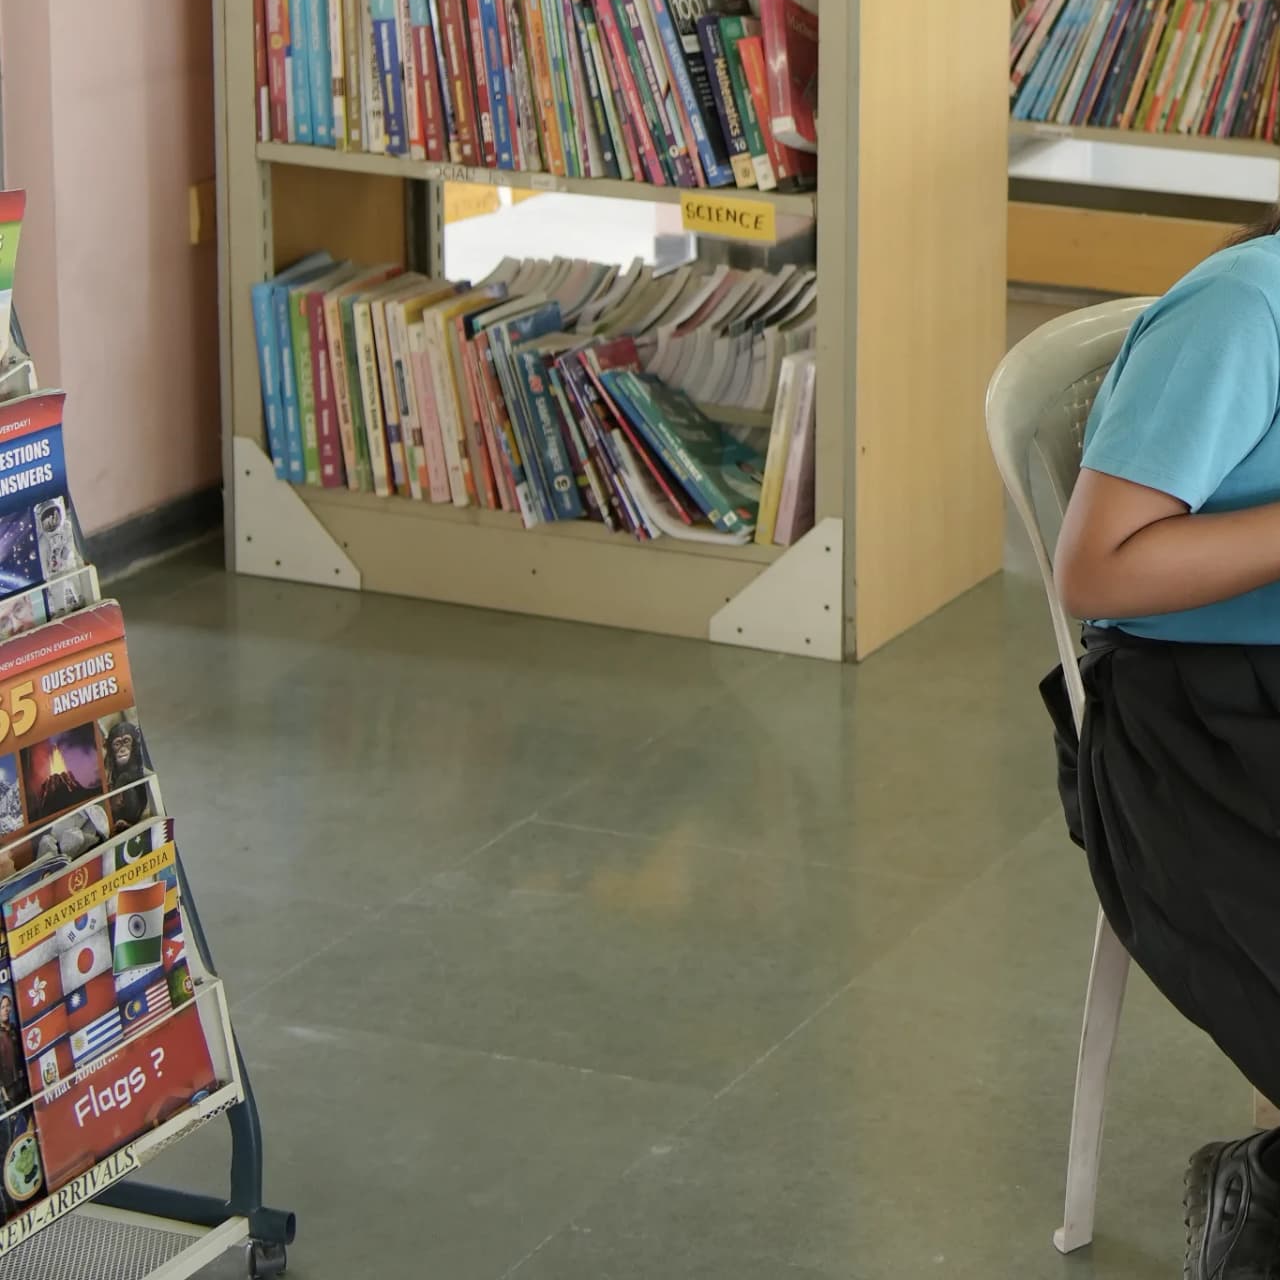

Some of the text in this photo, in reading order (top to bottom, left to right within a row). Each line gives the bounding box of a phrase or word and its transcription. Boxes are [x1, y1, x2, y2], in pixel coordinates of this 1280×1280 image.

[714, 57, 742, 137] Mathematics
[686, 202, 765, 231] SCIENCE
[0, 439, 50, 470] ESTIONS
[0, 464, 53, 498] NSWERS
[16, 647, 52, 666] QUESTION
[41, 652, 114, 693] QUESTIONS
[53, 676, 118, 715] ANSWERS
[18, 851, 169, 945] THE NAVNEET PICTOPEDIA
[73, 1066, 147, 1127] Flags
